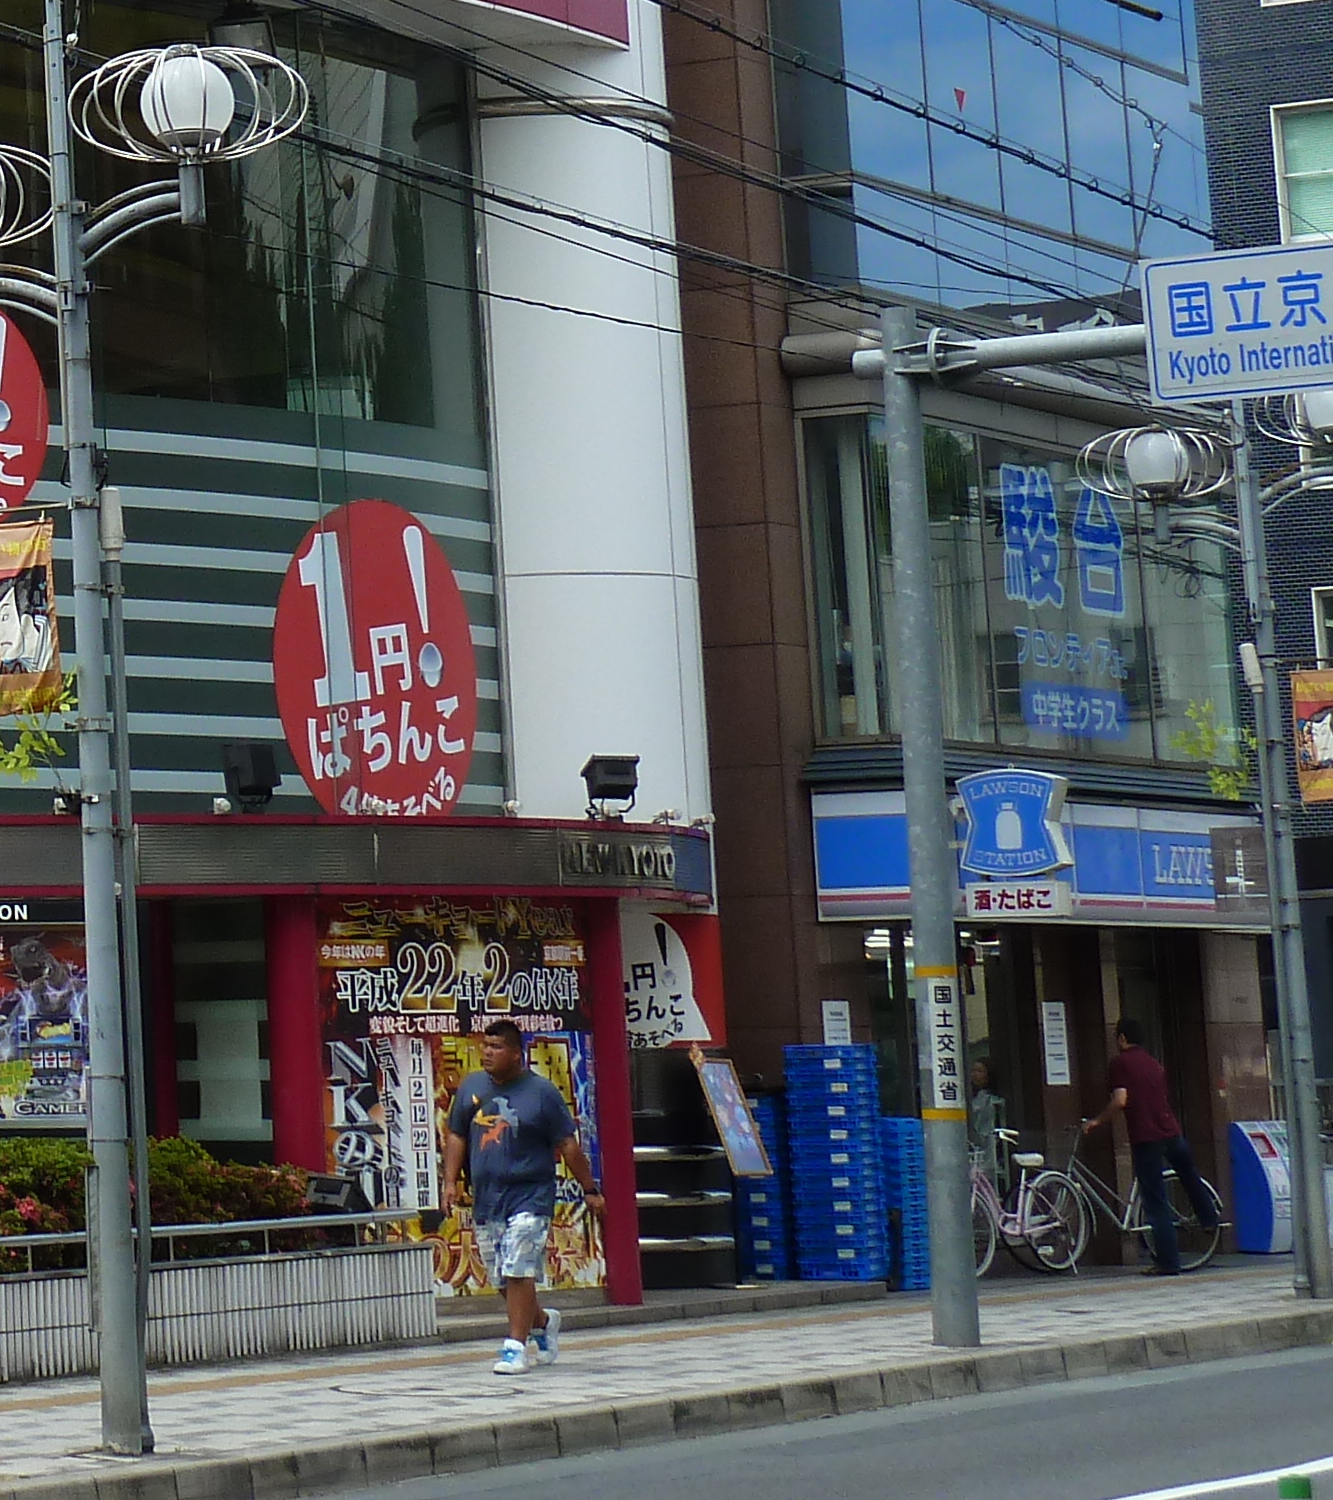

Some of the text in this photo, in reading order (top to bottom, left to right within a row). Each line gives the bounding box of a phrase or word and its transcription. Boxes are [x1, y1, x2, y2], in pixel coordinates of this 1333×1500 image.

[1168, 269, 1328, 338] 国立京
[1170, 346, 1231, 384] Kyoto
[298, 524, 443, 707] 1円!
[1032, 689, 1121, 733] 中学生クラス
[307, 695, 464, 780] ぱちんこ
[969, 780, 1045, 800] LAWSON
[973, 848, 1049, 869] STATION
[973, 888, 1053, 911] 酒・たばこ
[623, 921, 680, 991] 円!
[336, 940, 579, 1014] 平成22年2の付く年
[625, 993, 686, 1024] ちんこ
[933, 984, 958, 1101] 国土交通省
[412, 1079, 424, 1097] 2
[412, 1105, 426, 1124] 12
[412, 1130, 429, 1148] 22
